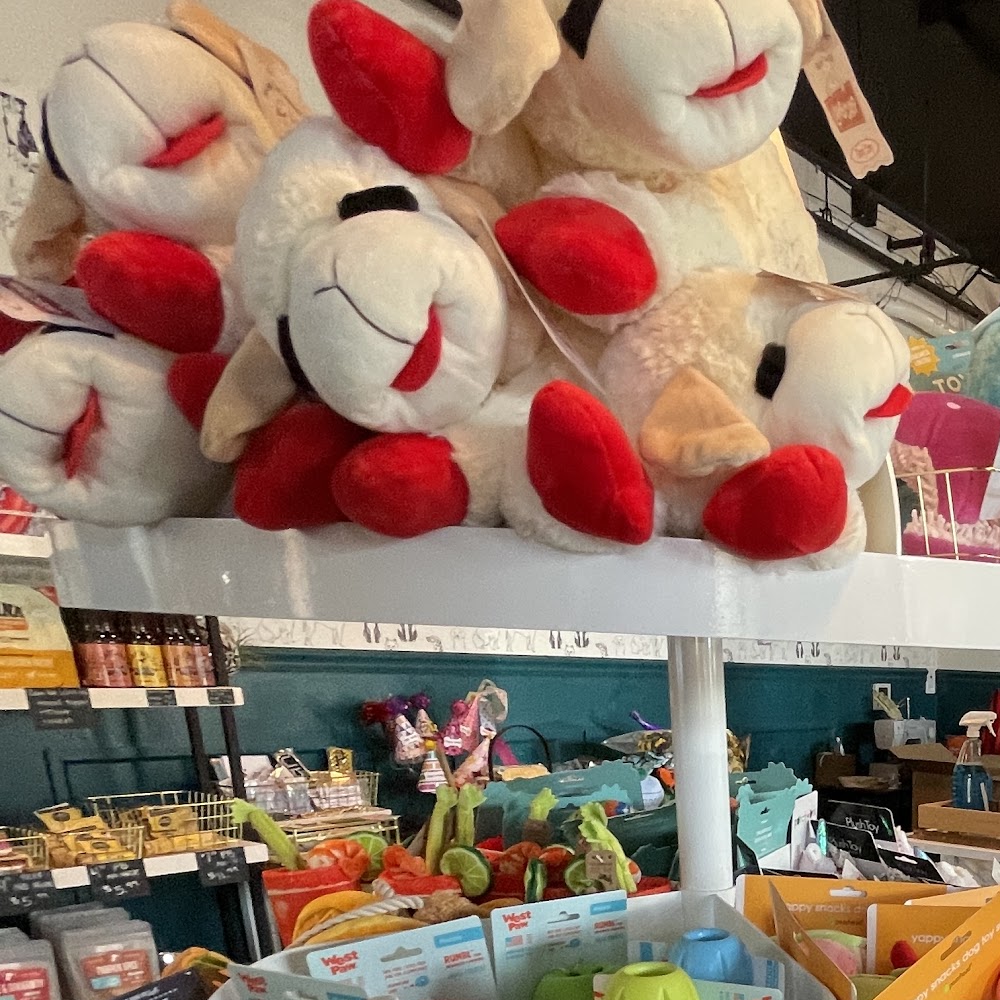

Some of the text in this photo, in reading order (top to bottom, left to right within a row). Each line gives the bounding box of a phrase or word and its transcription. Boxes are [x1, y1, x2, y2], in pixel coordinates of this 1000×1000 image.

[932, 373, 965, 393] TO
[502, 910, 532, 922] West
[508, 922, 529, 932] Paw
[320, 950, 359, 966] West
[930, 960, 962, 991] snacks
[962, 942, 981, 962] dog
[980, 929, 995, 946] toy
[330, 963, 357, 976] Paw
